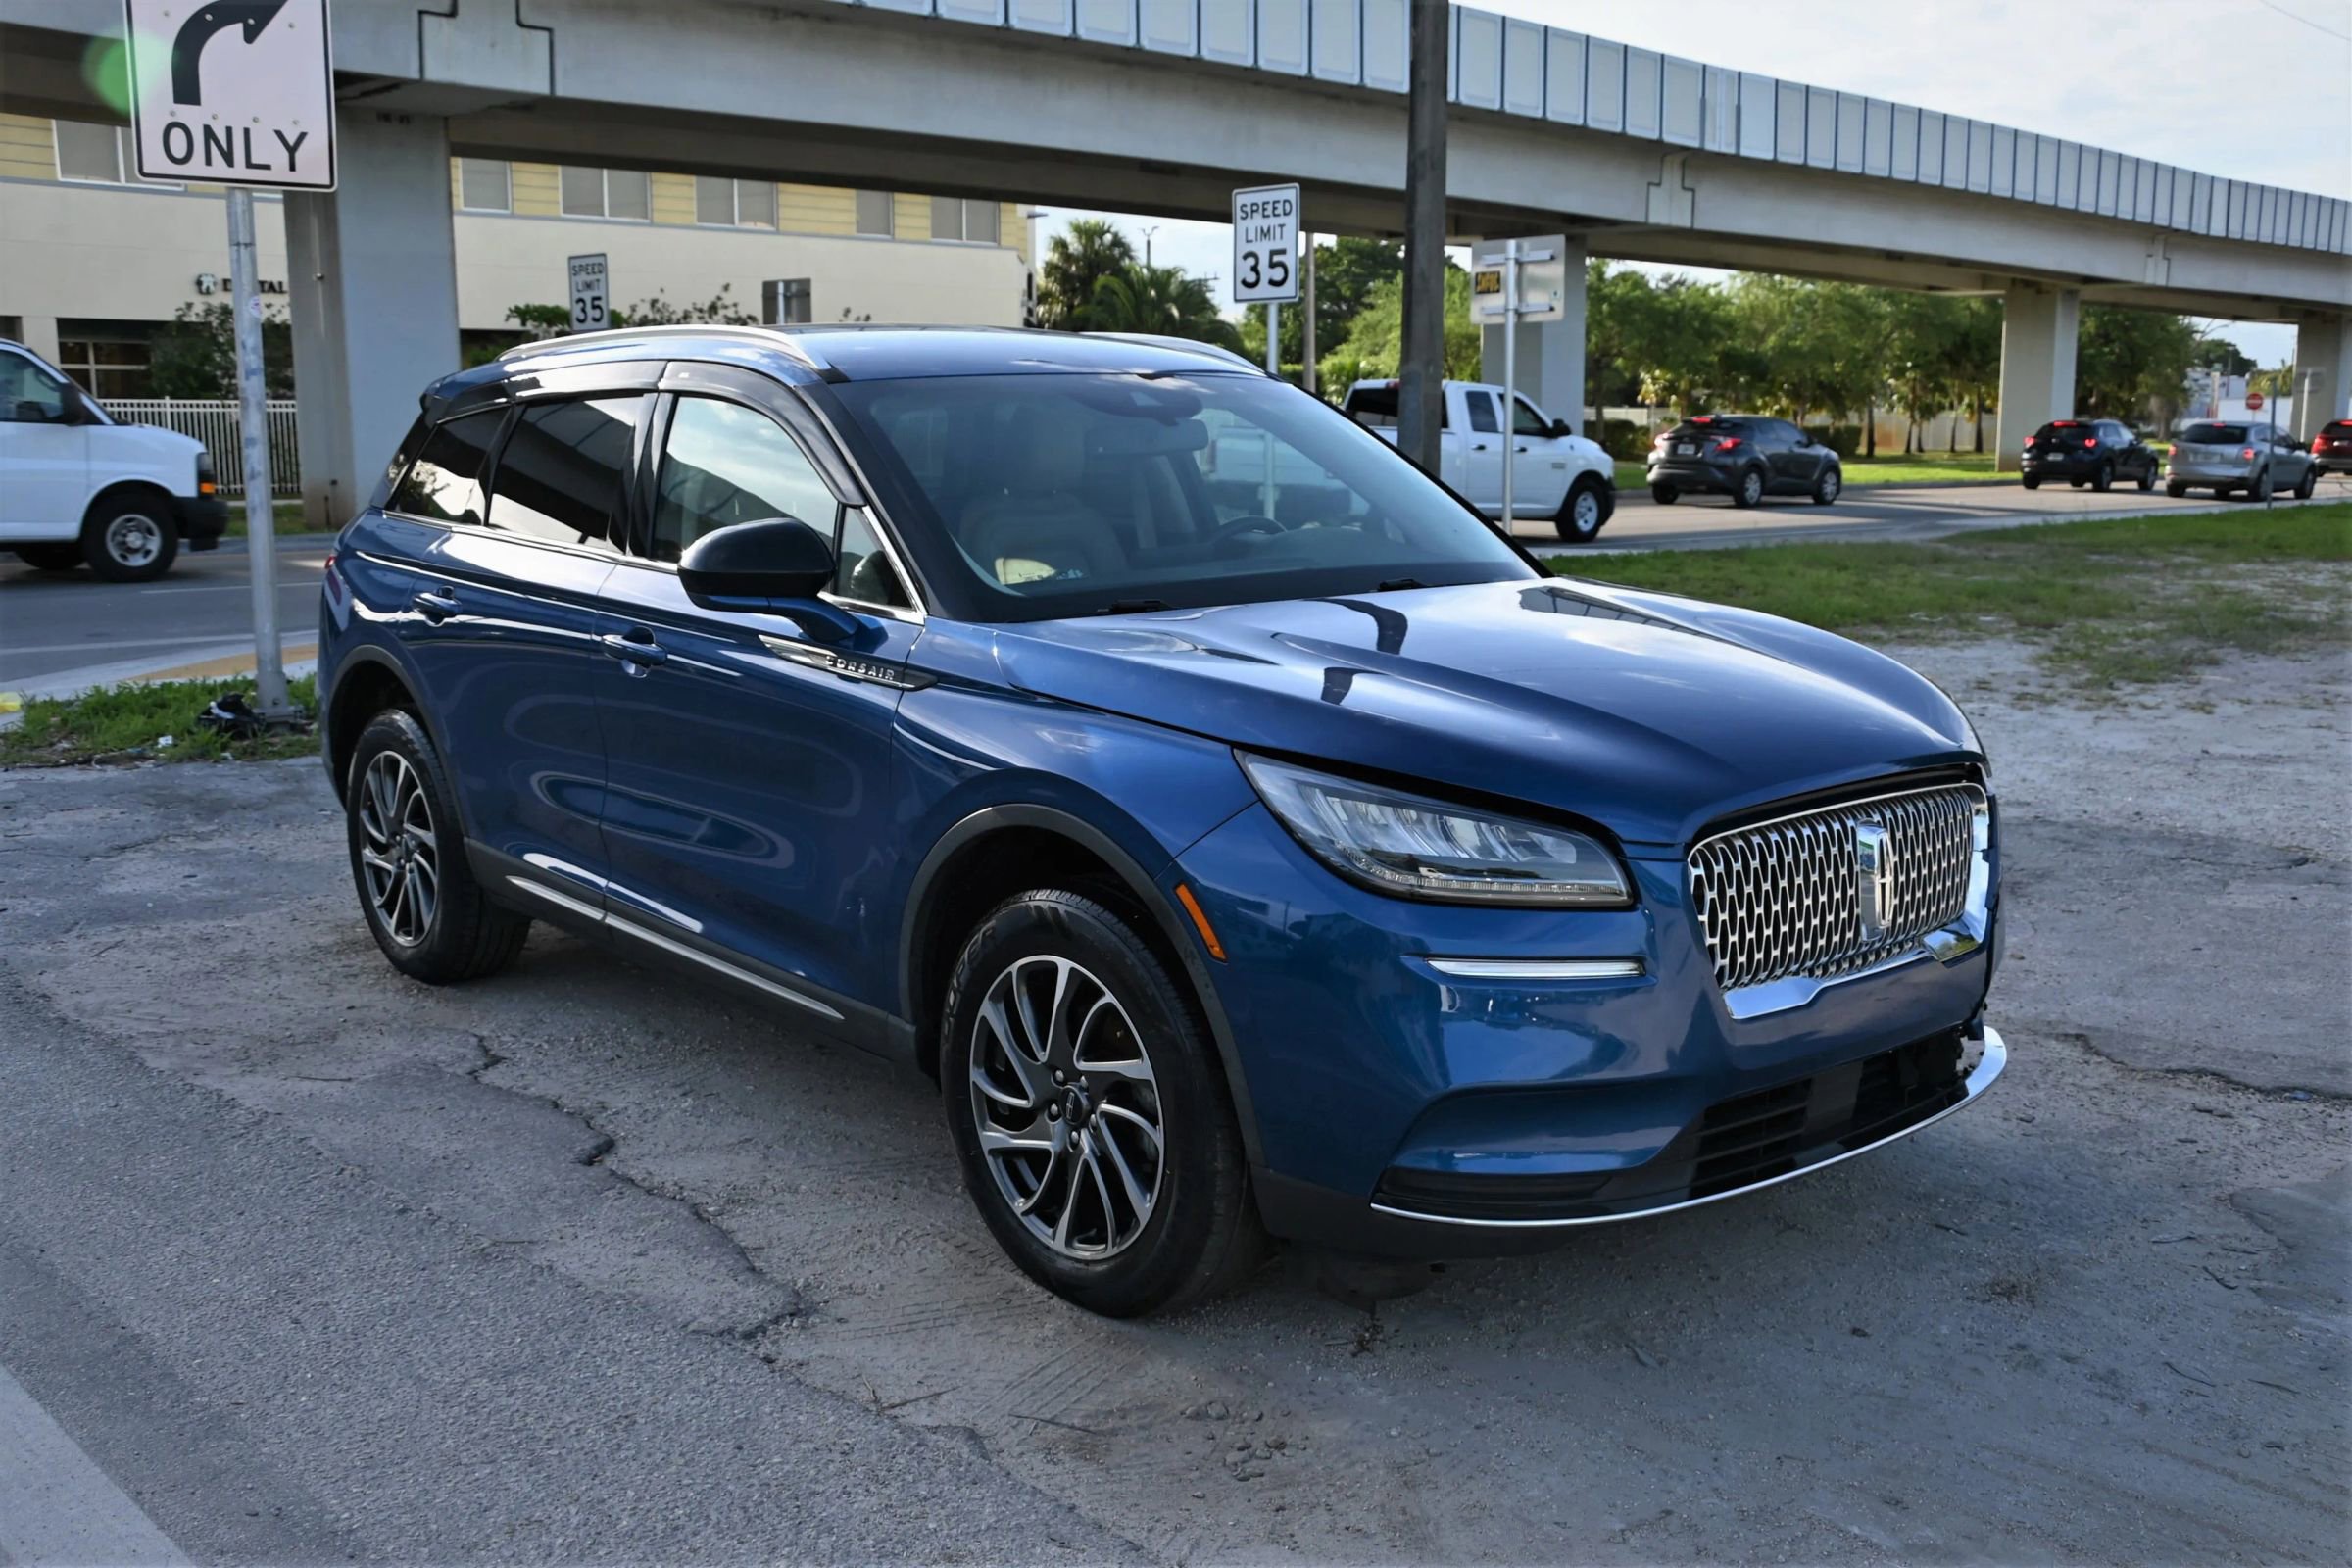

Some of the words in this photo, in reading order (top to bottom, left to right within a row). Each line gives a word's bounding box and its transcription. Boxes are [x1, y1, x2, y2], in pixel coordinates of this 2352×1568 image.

[163, 121, 309, 172] ONLY
[1240, 199, 1293, 220] SPEED
[1245, 223, 1286, 243] LIMIT
[572, 263, 604, 276] SPEED
[1241, 248, 1289, 289] 35
[222, 278, 288, 294] DTAL
[575, 296, 604, 324] 35
[825, 656, 895, 680] CORSAIR
